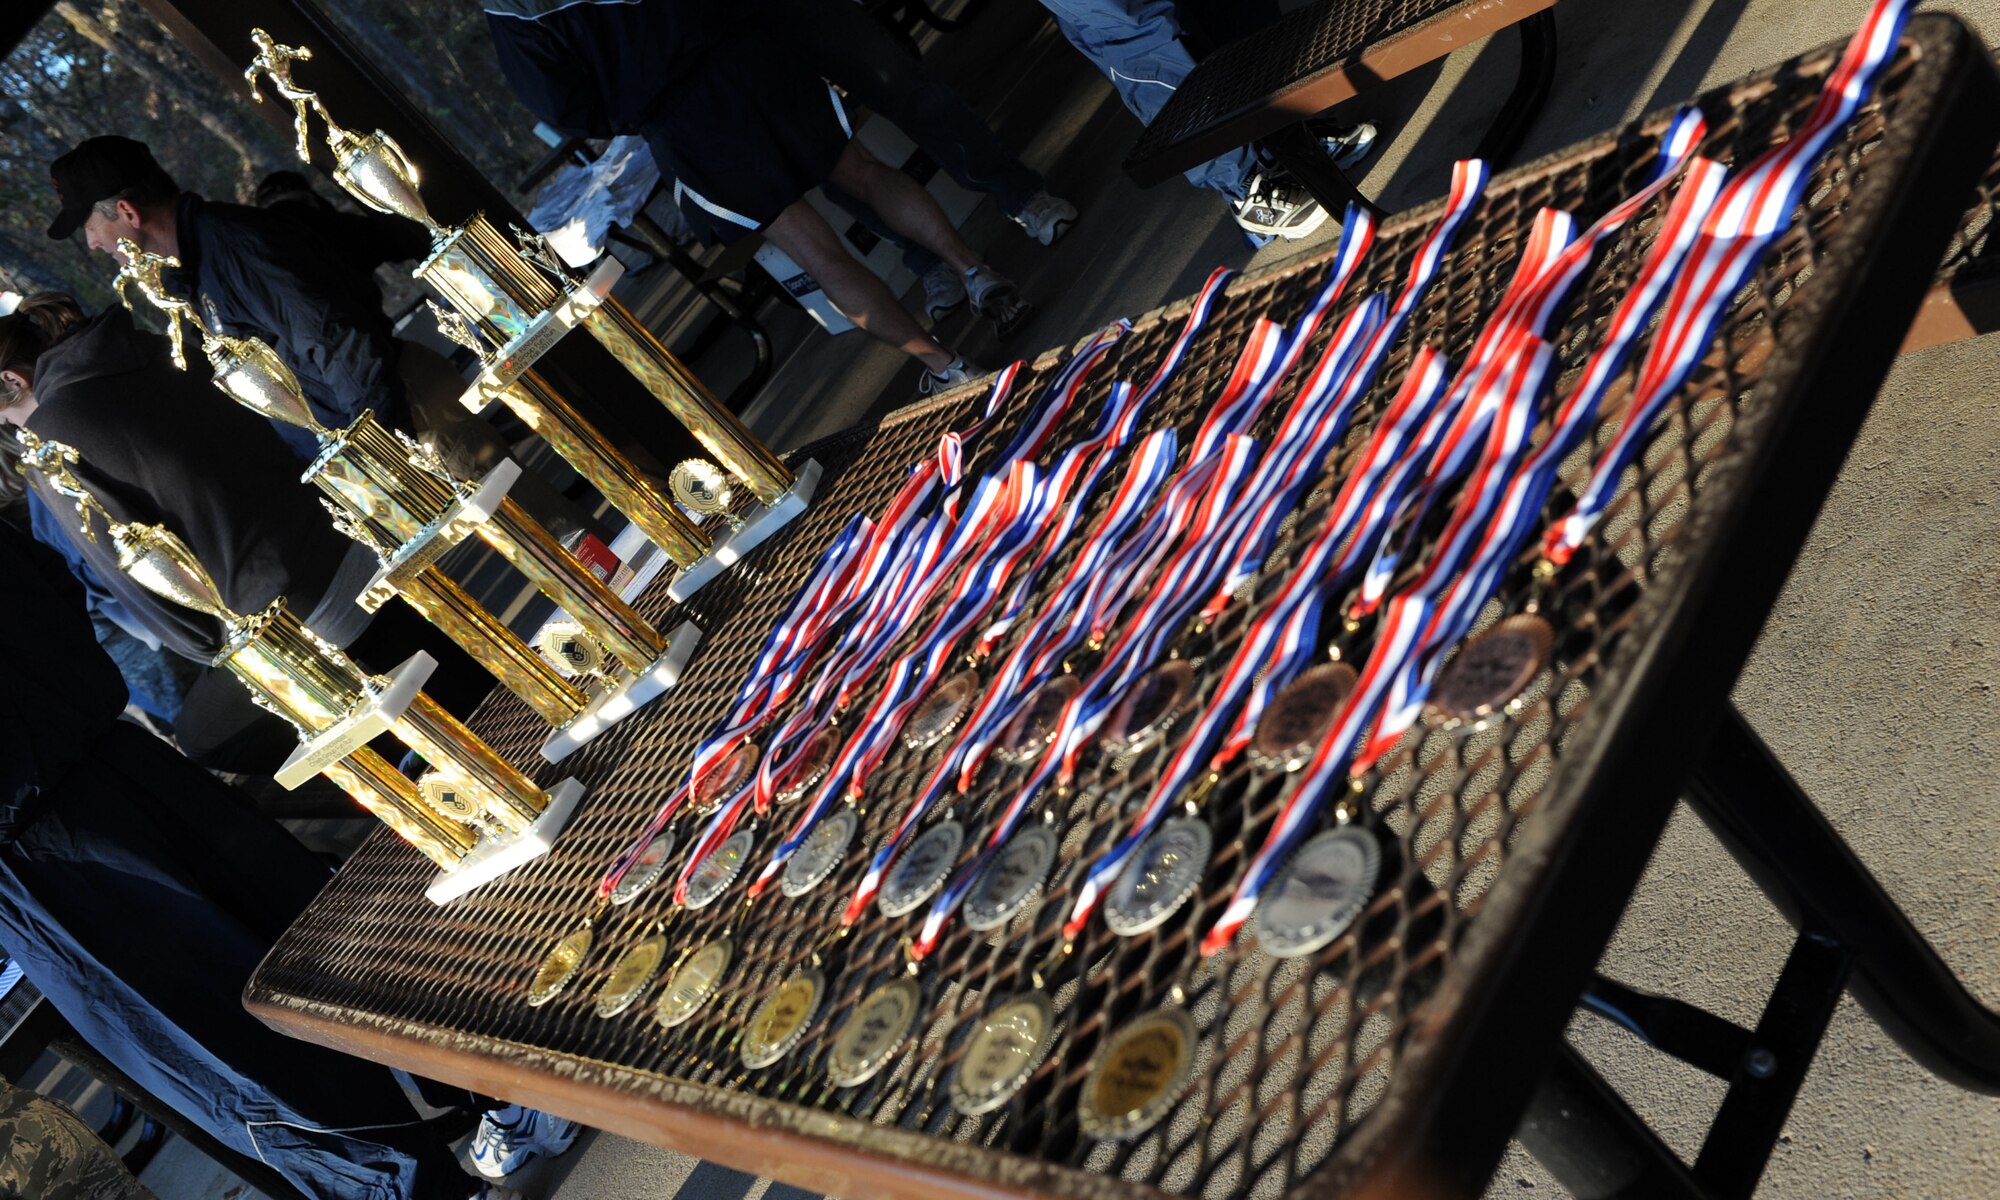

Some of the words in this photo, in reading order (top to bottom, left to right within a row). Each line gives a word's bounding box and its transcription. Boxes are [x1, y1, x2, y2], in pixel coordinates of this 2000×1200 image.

[517, 346, 536, 362] Group
[534, 337, 545, 347] Fun
[544, 328, 556, 339] Run
[539, 338, 554, 352] 2010
